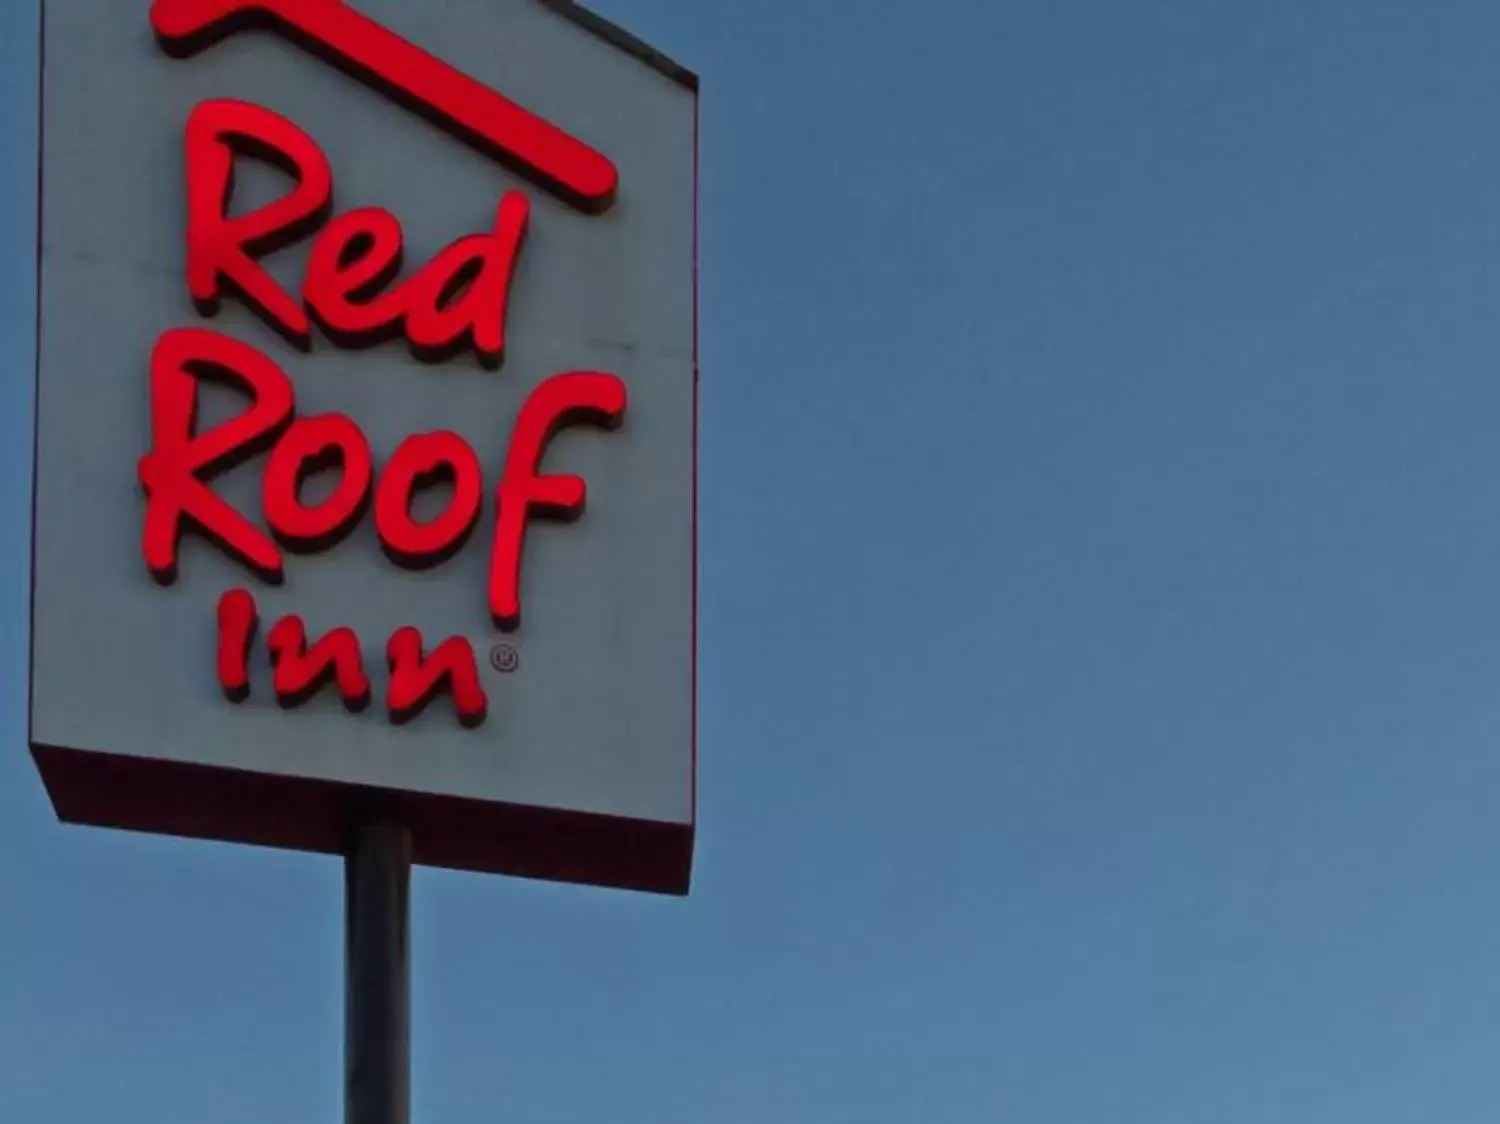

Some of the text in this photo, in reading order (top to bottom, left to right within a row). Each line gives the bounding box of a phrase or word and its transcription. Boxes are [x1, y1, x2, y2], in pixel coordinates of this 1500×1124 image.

[185, 98, 528, 365] Red
[138, 328, 626, 626] Roof
[217, 588, 487, 724] Inn
